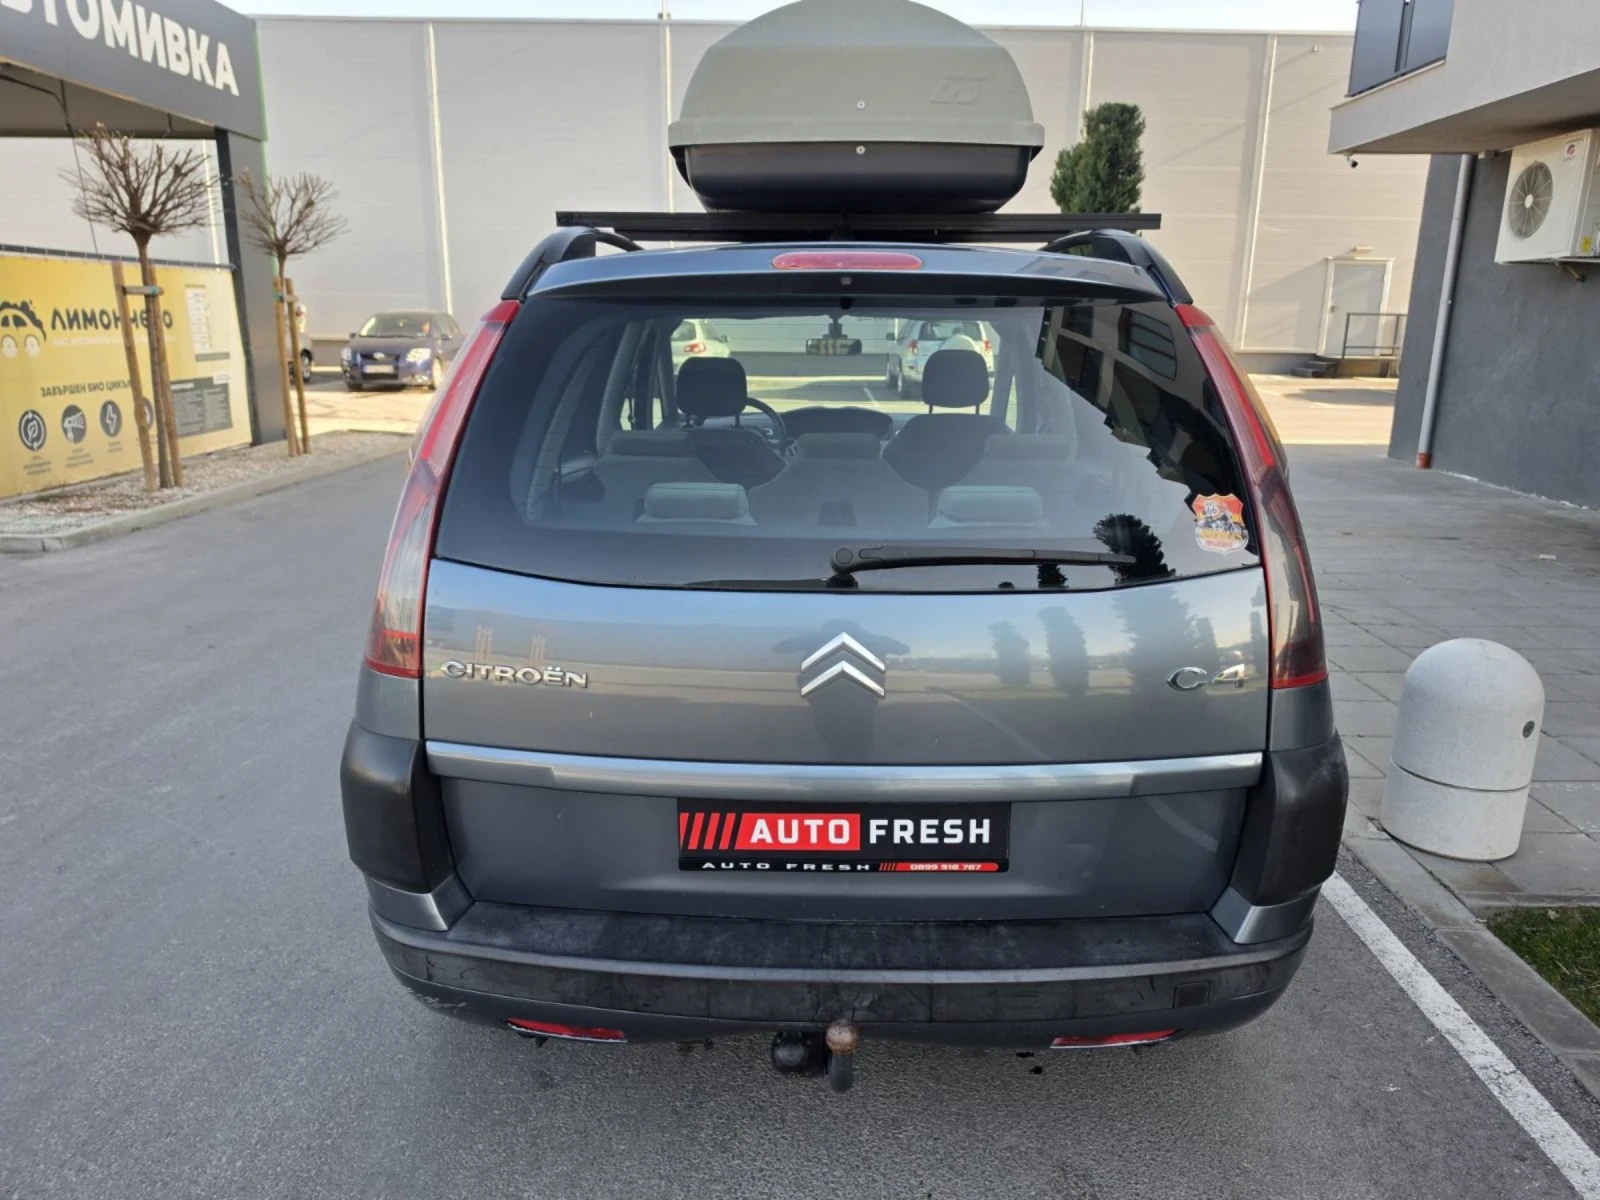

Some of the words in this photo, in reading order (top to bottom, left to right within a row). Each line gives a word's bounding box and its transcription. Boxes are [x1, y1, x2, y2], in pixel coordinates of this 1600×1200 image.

[40, 383, 86, 397] ЗАВЪРШЕН
[87, 381, 105, 393] БИО
[440, 660, 588, 689] CITROËN
[750, 818, 850, 845] AUTO
[869, 818, 991, 845] FRESH
[702, 861, 771, 871] AUTO
[786, 862, 870, 871] FRESH
